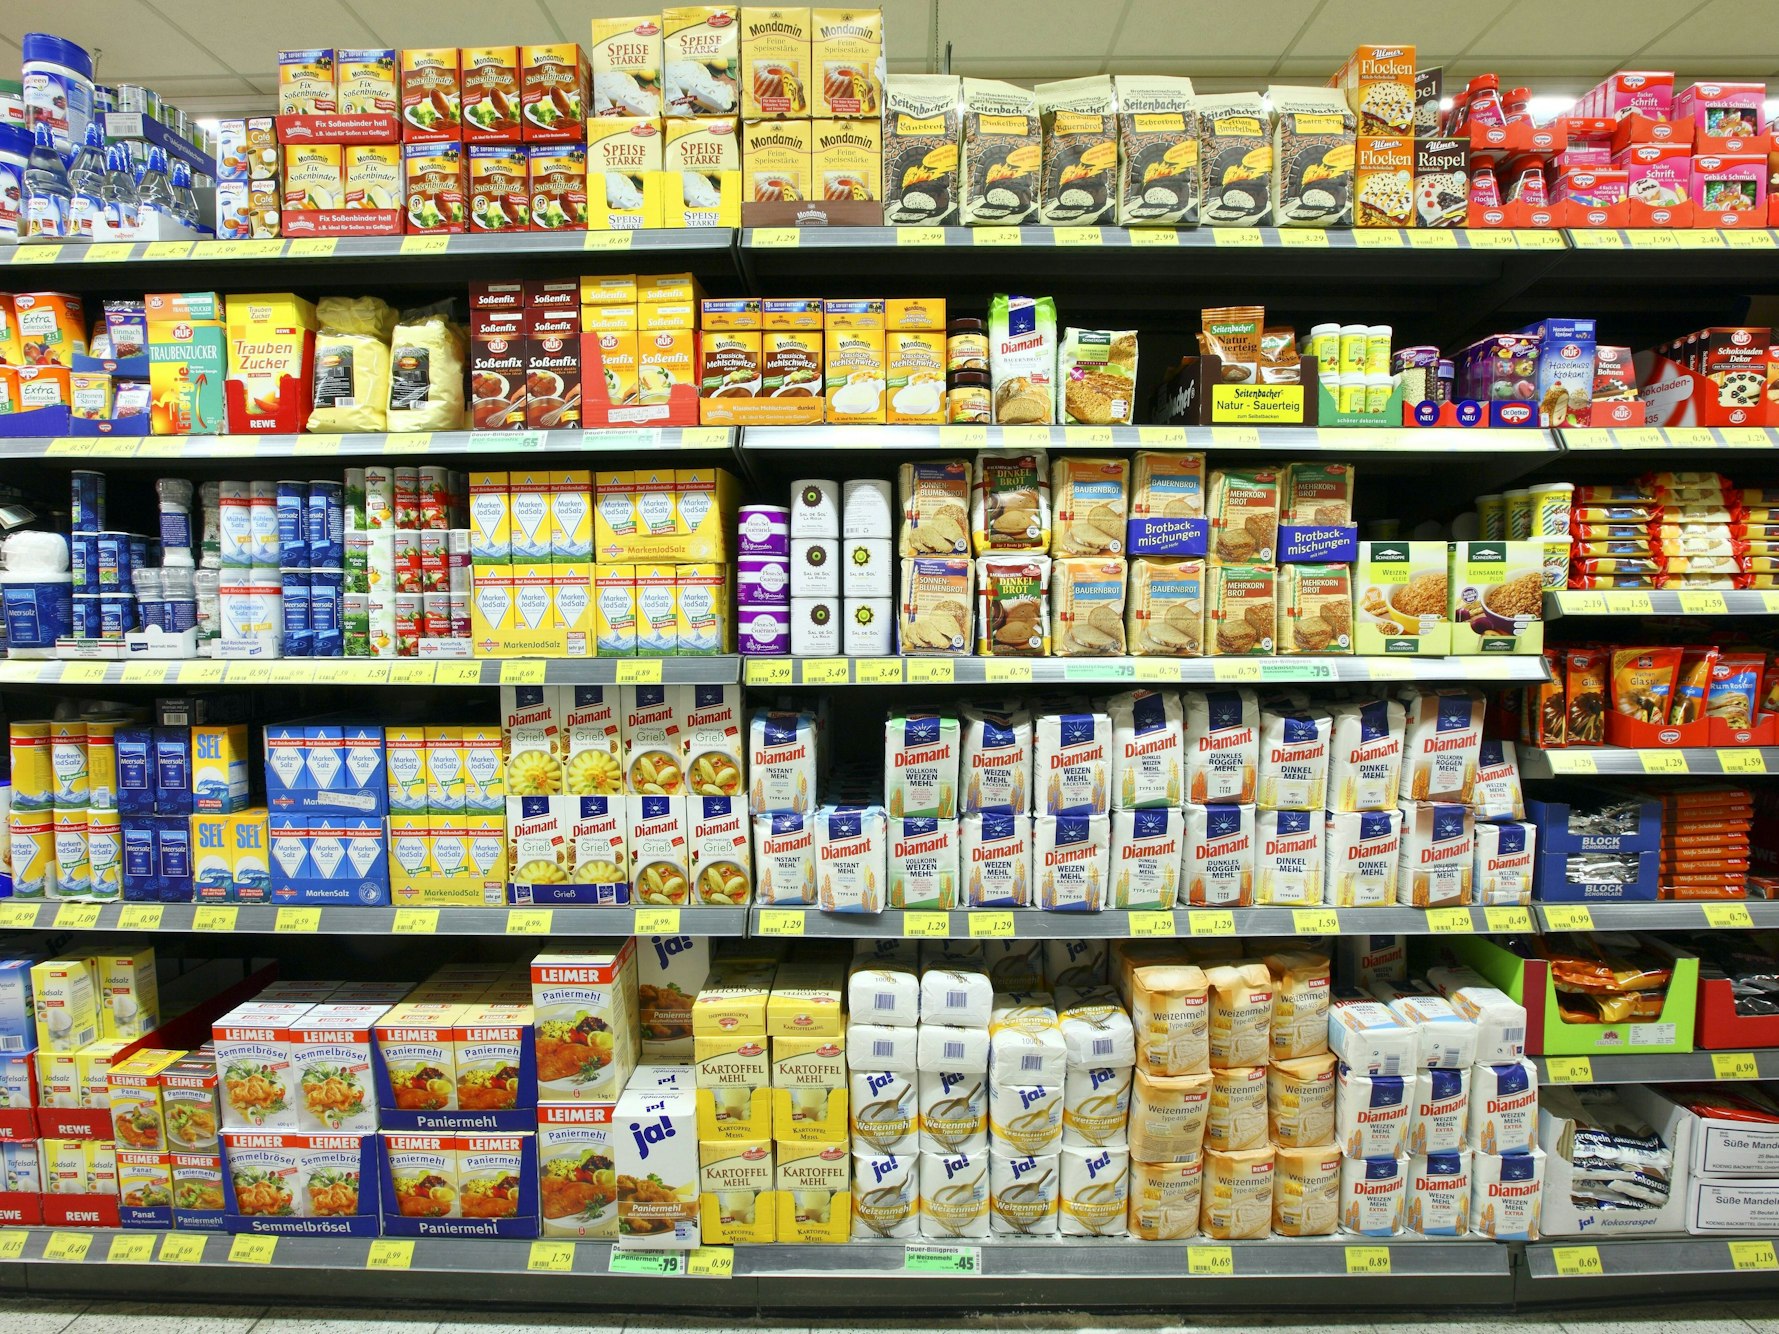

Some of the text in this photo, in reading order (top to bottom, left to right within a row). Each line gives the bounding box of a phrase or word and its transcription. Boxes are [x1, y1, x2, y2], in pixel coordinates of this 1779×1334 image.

[750, 24, 801, 37] Mondamin
[608, 43, 649, 57] SPEISE
[754, 45, 799, 53] Speisestärke
[1372, 49, 1403, 59] Ulmer
[1361, 60, 1412, 75] Flocken
[352, 71, 379, 79] Mondamin
[344, 90, 390, 98] Soßenbinder
[1123, 99, 1187, 111] Seitenbacher
[1631, 98, 1658, 106] Schrift
[751, 134, 803, 148] Mondamin
[680, 142, 723, 155] SPEISE
[1426, 141, 1458, 152] Ulmer
[1419, 153, 1465, 167] Raspel
[23, 314, 51, 326] Extra
[173, 328, 191, 338] RUF
[1212, 324, 1254, 334] Seitenbacher
[234, 341, 292, 354] Trauben
[716, 341, 747, 350] Mondamin
[1001, 336, 1043, 354] Diamant
[151, 346, 217, 360] TRAUBENZUCKER
[240, 356, 289, 369] Zucker
[475, 358, 522, 369] Soßenfix
[641, 354, 688, 363] Soßenfix
[1729, 355, 1752, 363] Dekor
[707, 361, 756, 370] Mehlschwitze
[1548, 362, 1590, 370] Haselnuss
[178, 366, 193, 430] Energie
[1235, 389, 1283, 399] Seitenbacher
[1217, 400, 1243, 410] Natur
[1254, 400, 1300, 412] Sauerteig
[250, 419, 276, 428] REWE
[920, 489, 963, 497] BLUMENBROT
[1074, 485, 1120, 494] BAUERNBROT
[1230, 490, 1266, 499] MEHRKORN
[1145, 522, 1195, 534] Brotback-
[1138, 530, 1201, 545] mischungen
[1295, 530, 1344, 543] Brotback-
[627, 546, 685, 554] MarkenJodSalz
[1287, 538, 1350, 554] mischungen
[1000, 577, 1034, 586] DINKEL
[1002, 585, 1029, 595] BROT
[1584, 600, 1602, 608] 2.19
[504, 641, 561, 649] MarkenJodSalz
[144, 668, 163, 676] 1.99
[459, 669, 478, 678] 1.59
[770, 669, 791, 677] 3.99
[880, 668, 900, 676] 3.49
[931, 667, 951, 675] 0.79
[509, 708, 552, 727] Diamant
[516, 732, 545, 741] Grieß
[197, 733, 221, 759] SEL
[1125, 733, 1177, 757] Diamant
[1424, 732, 1477, 753] Diamant
[755, 745, 805, 765] Diamant
[1271, 744, 1324, 762] Diamant
[696, 818, 740, 838] Diamant
[1582, 837, 1620, 845] BLOCK
[1045, 844, 1098, 866] Diamant
[306, 889, 349, 897] MarkenSalz
[554, 890, 576, 898] Grieß
[15, 912, 34, 920] 0.99
[1730, 913, 1747, 921] 0.79
[782, 919, 802, 928] 1.29
[1318, 918, 1336, 926] 1.59
[541, 970, 599, 982] LEIMER
[542, 990, 601, 1002] Paniermehl
[1153, 1009, 1206, 1021] Weizenmehl
[1218, 1006, 1270, 1017] Weizenmehl
[226, 1029, 275, 1041] LEIMER
[218, 1046, 288, 1060] Semmelbrösel
[702, 1064, 764, 1075] KARTOFFEL
[1570, 1067, 1588, 1076] 0.79
[719, 1075, 747, 1083] MEHL
[867, 1072, 894, 1097] ja!
[1358, 1106, 1408, 1123] Diamant
[418, 1116, 497, 1128] Paniermehl
[856, 1121, 912, 1131] Weizenmehl
[632, 1204, 681, 1213] Paniermehl
[66, 1211, 99, 1222] REWE
[253, 1221, 351, 1233] Semmelbrösel
[1578, 1216, 1657, 1230] ja! Kokosraspel
[906, 1246, 958, 1254] Dauer-Billigpreis
[552, 1253, 571, 1263] 1.79
[1579, 1258, 1597, 1267] 0.69
